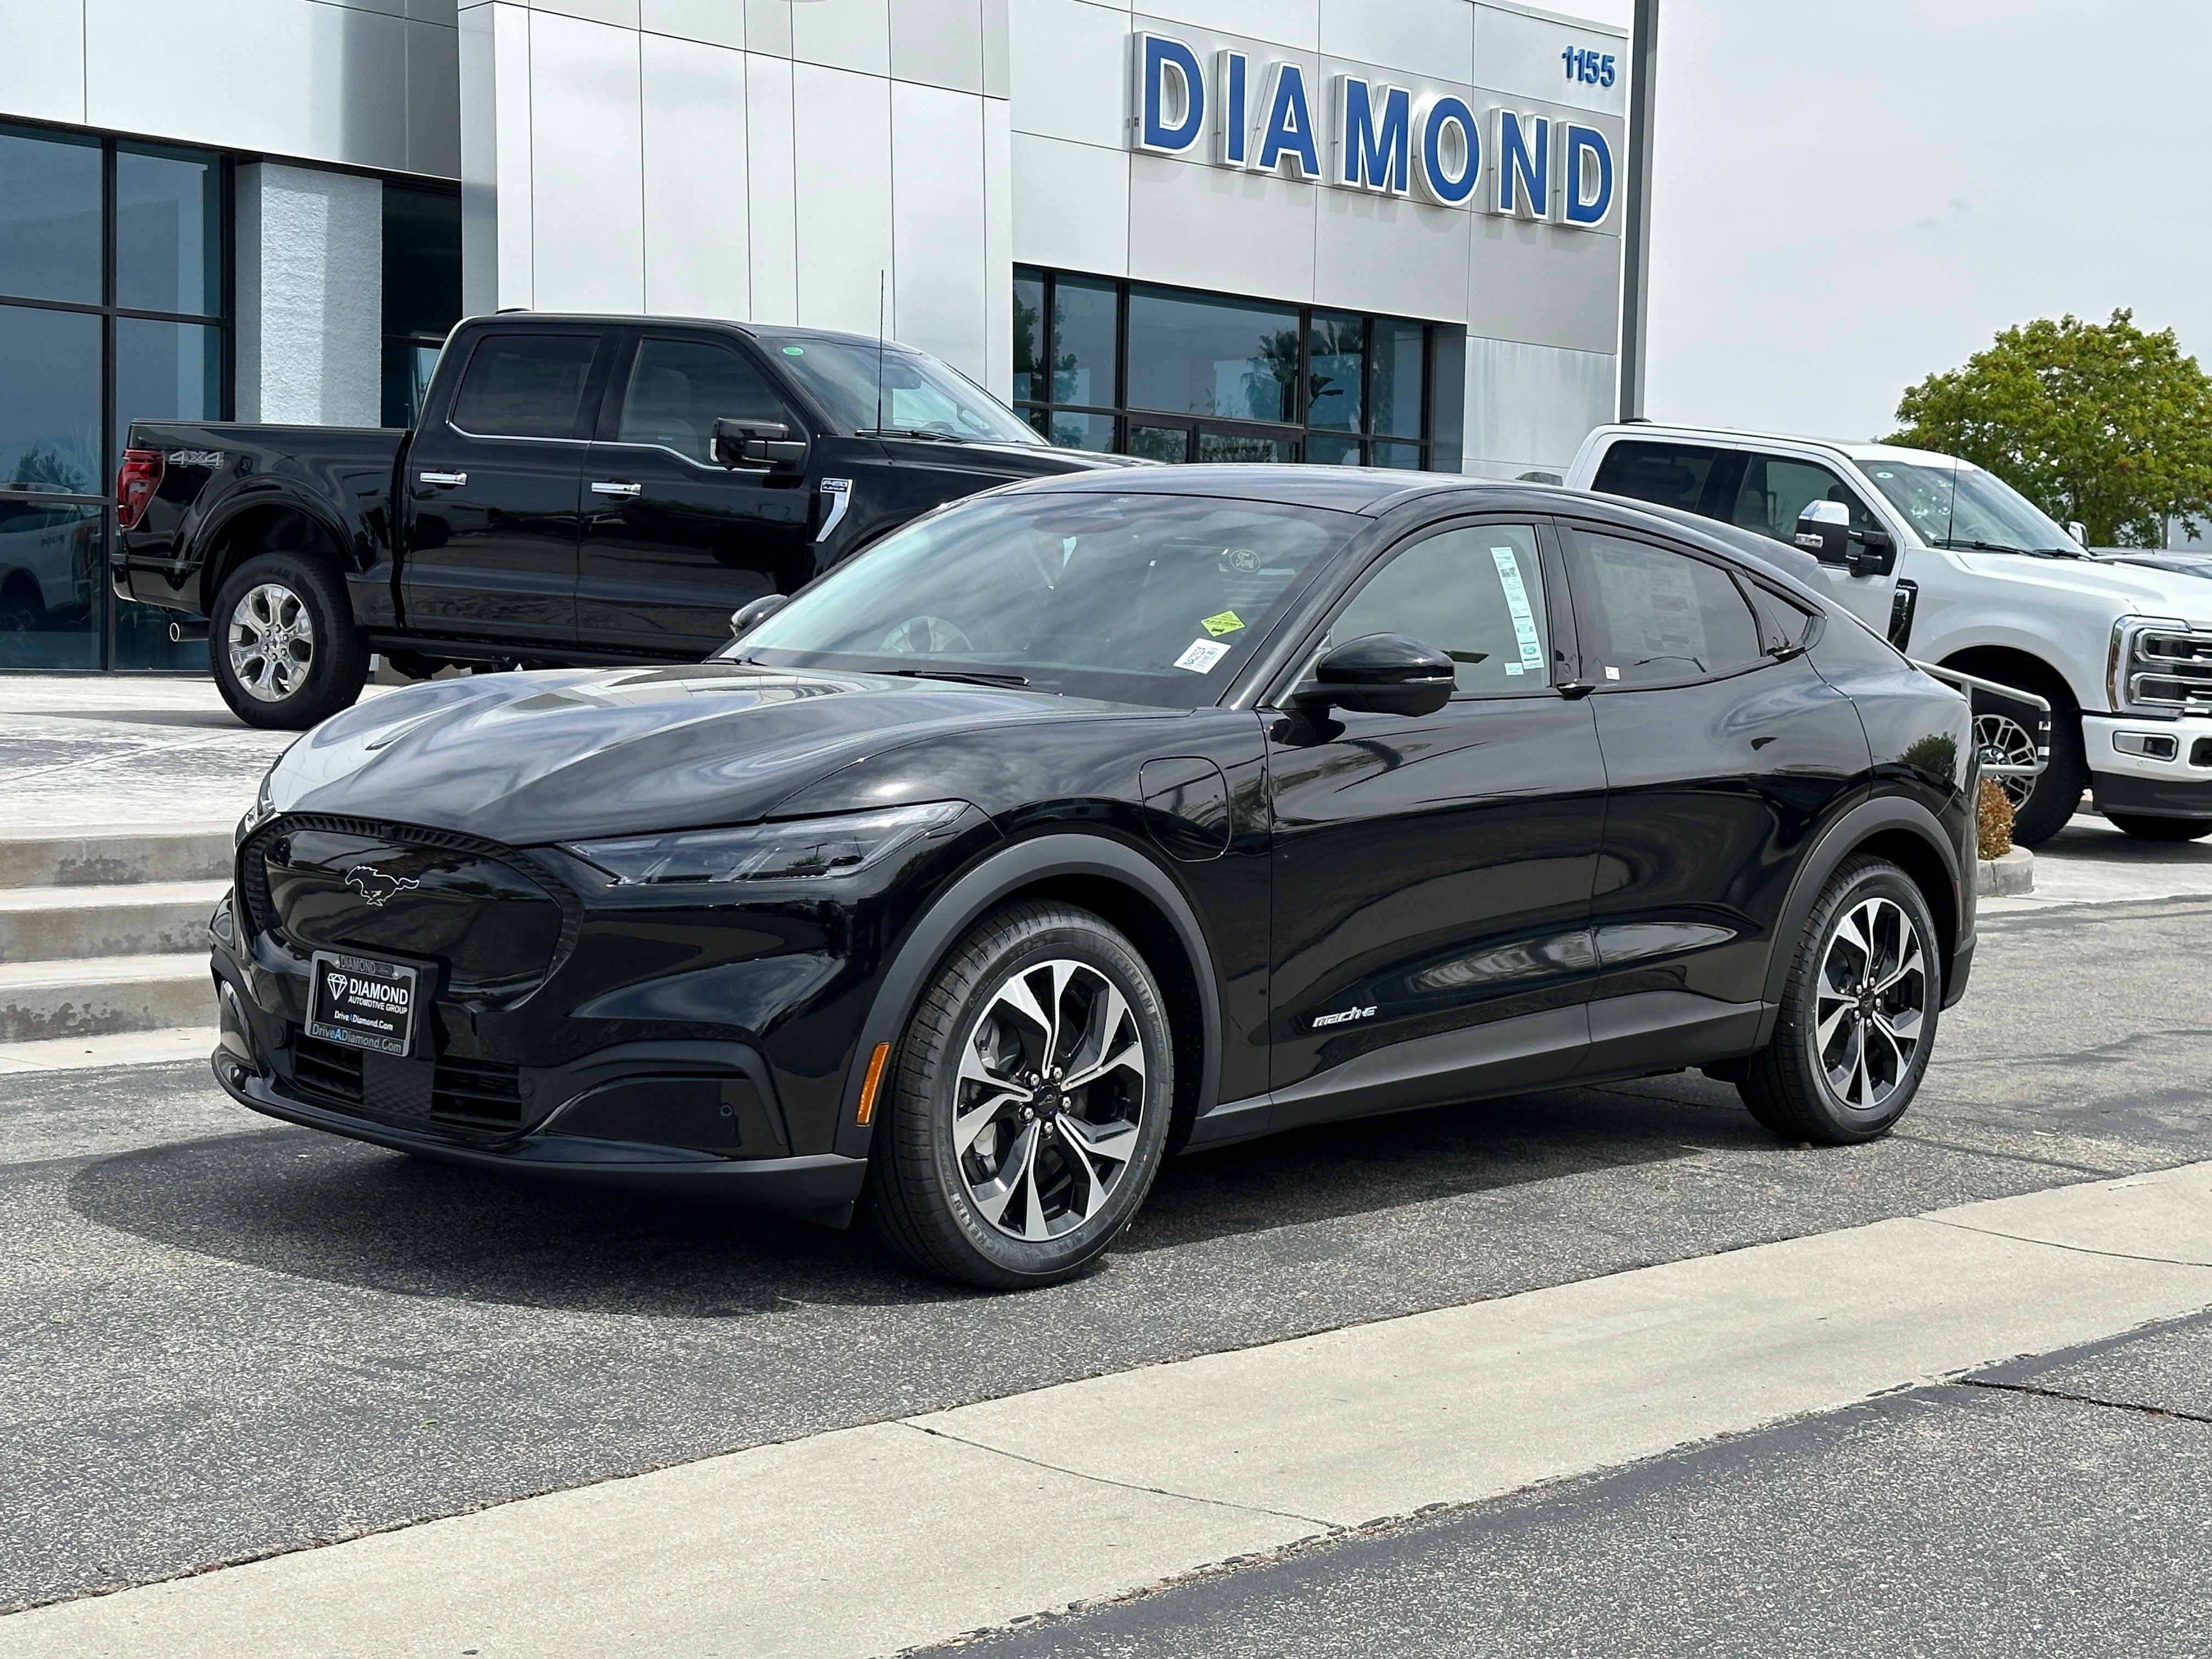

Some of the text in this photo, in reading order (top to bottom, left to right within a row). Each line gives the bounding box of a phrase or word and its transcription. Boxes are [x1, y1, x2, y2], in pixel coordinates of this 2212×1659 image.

[1562, 46, 1615, 87] 1155
[1135, 31, 1615, 228] DIAMOND
[340, 956, 376, 974] DIAMOND
[348, 995, 408, 1014] AUTOMOTIVE GROUP
[349, 978, 409, 1005] DIAMOND
[312, 1023, 402, 1053] DriveADiamond.Com
